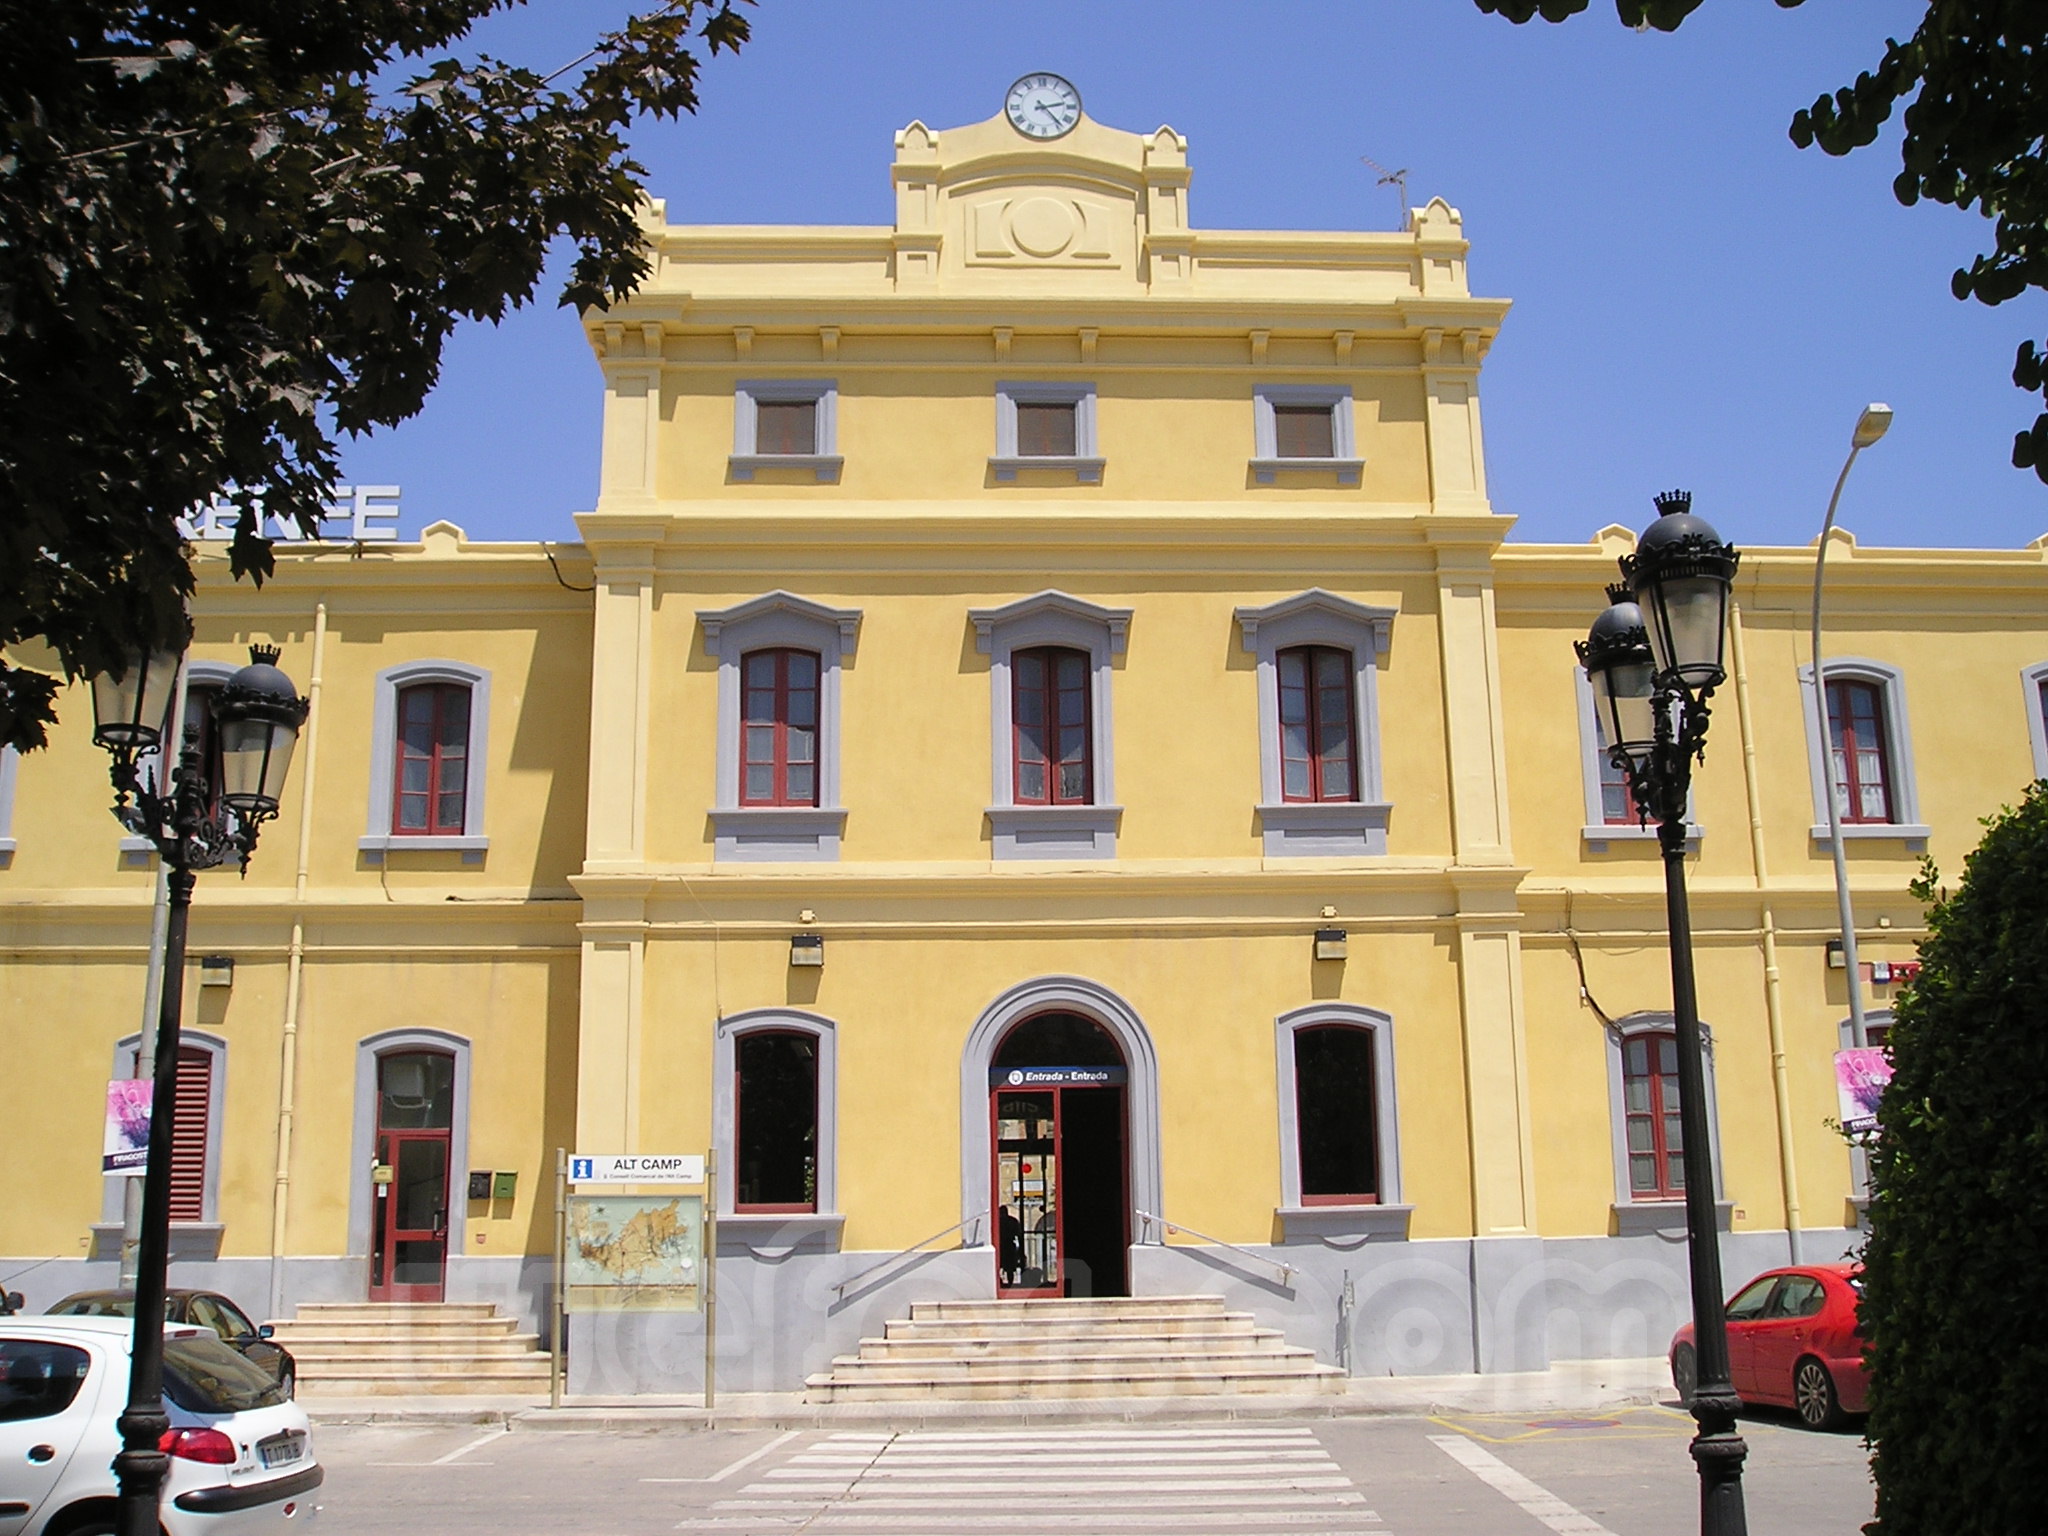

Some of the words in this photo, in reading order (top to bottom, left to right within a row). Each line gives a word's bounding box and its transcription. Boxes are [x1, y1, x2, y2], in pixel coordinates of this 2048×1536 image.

[1025, 1071, 1063, 1082] Entrada
[1071, 1070, 1108, 1081] Entrada
[613, 1158, 638, 1170] ALT
[641, 1158, 682, 1170] CAMP
